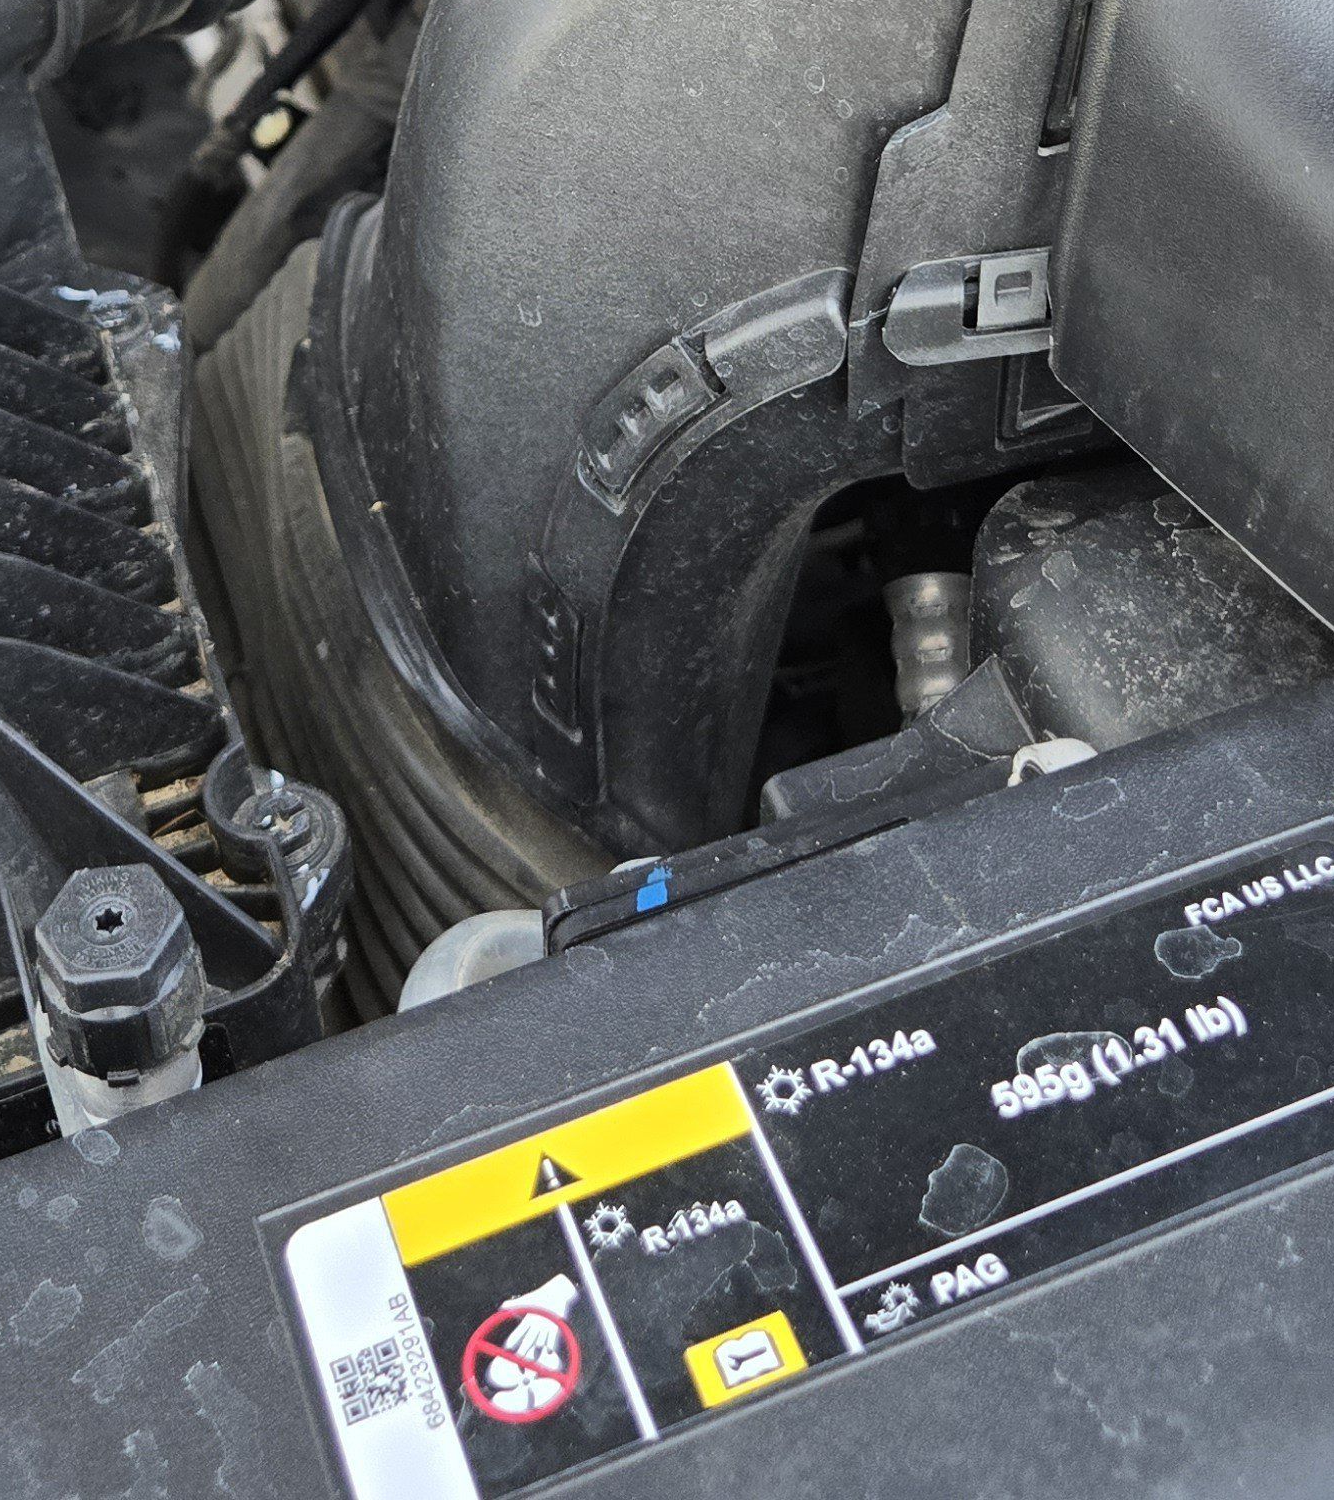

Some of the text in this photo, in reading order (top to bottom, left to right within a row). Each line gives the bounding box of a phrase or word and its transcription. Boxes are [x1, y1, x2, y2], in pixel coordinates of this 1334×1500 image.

[80, 872, 131, 891] VIKING
[1184, 891, 1247, 927] FCA
[1241, 875, 1285, 908] US
[810, 1028, 938, 1094] R-134a
[991, 995, 1250, 1120] 595g (1.31 lb)
[639, 1199, 748, 1257] R-134a
[930, 1252, 1011, 1307] PAG
[387, 1291, 447, 1430] 68423291AB
